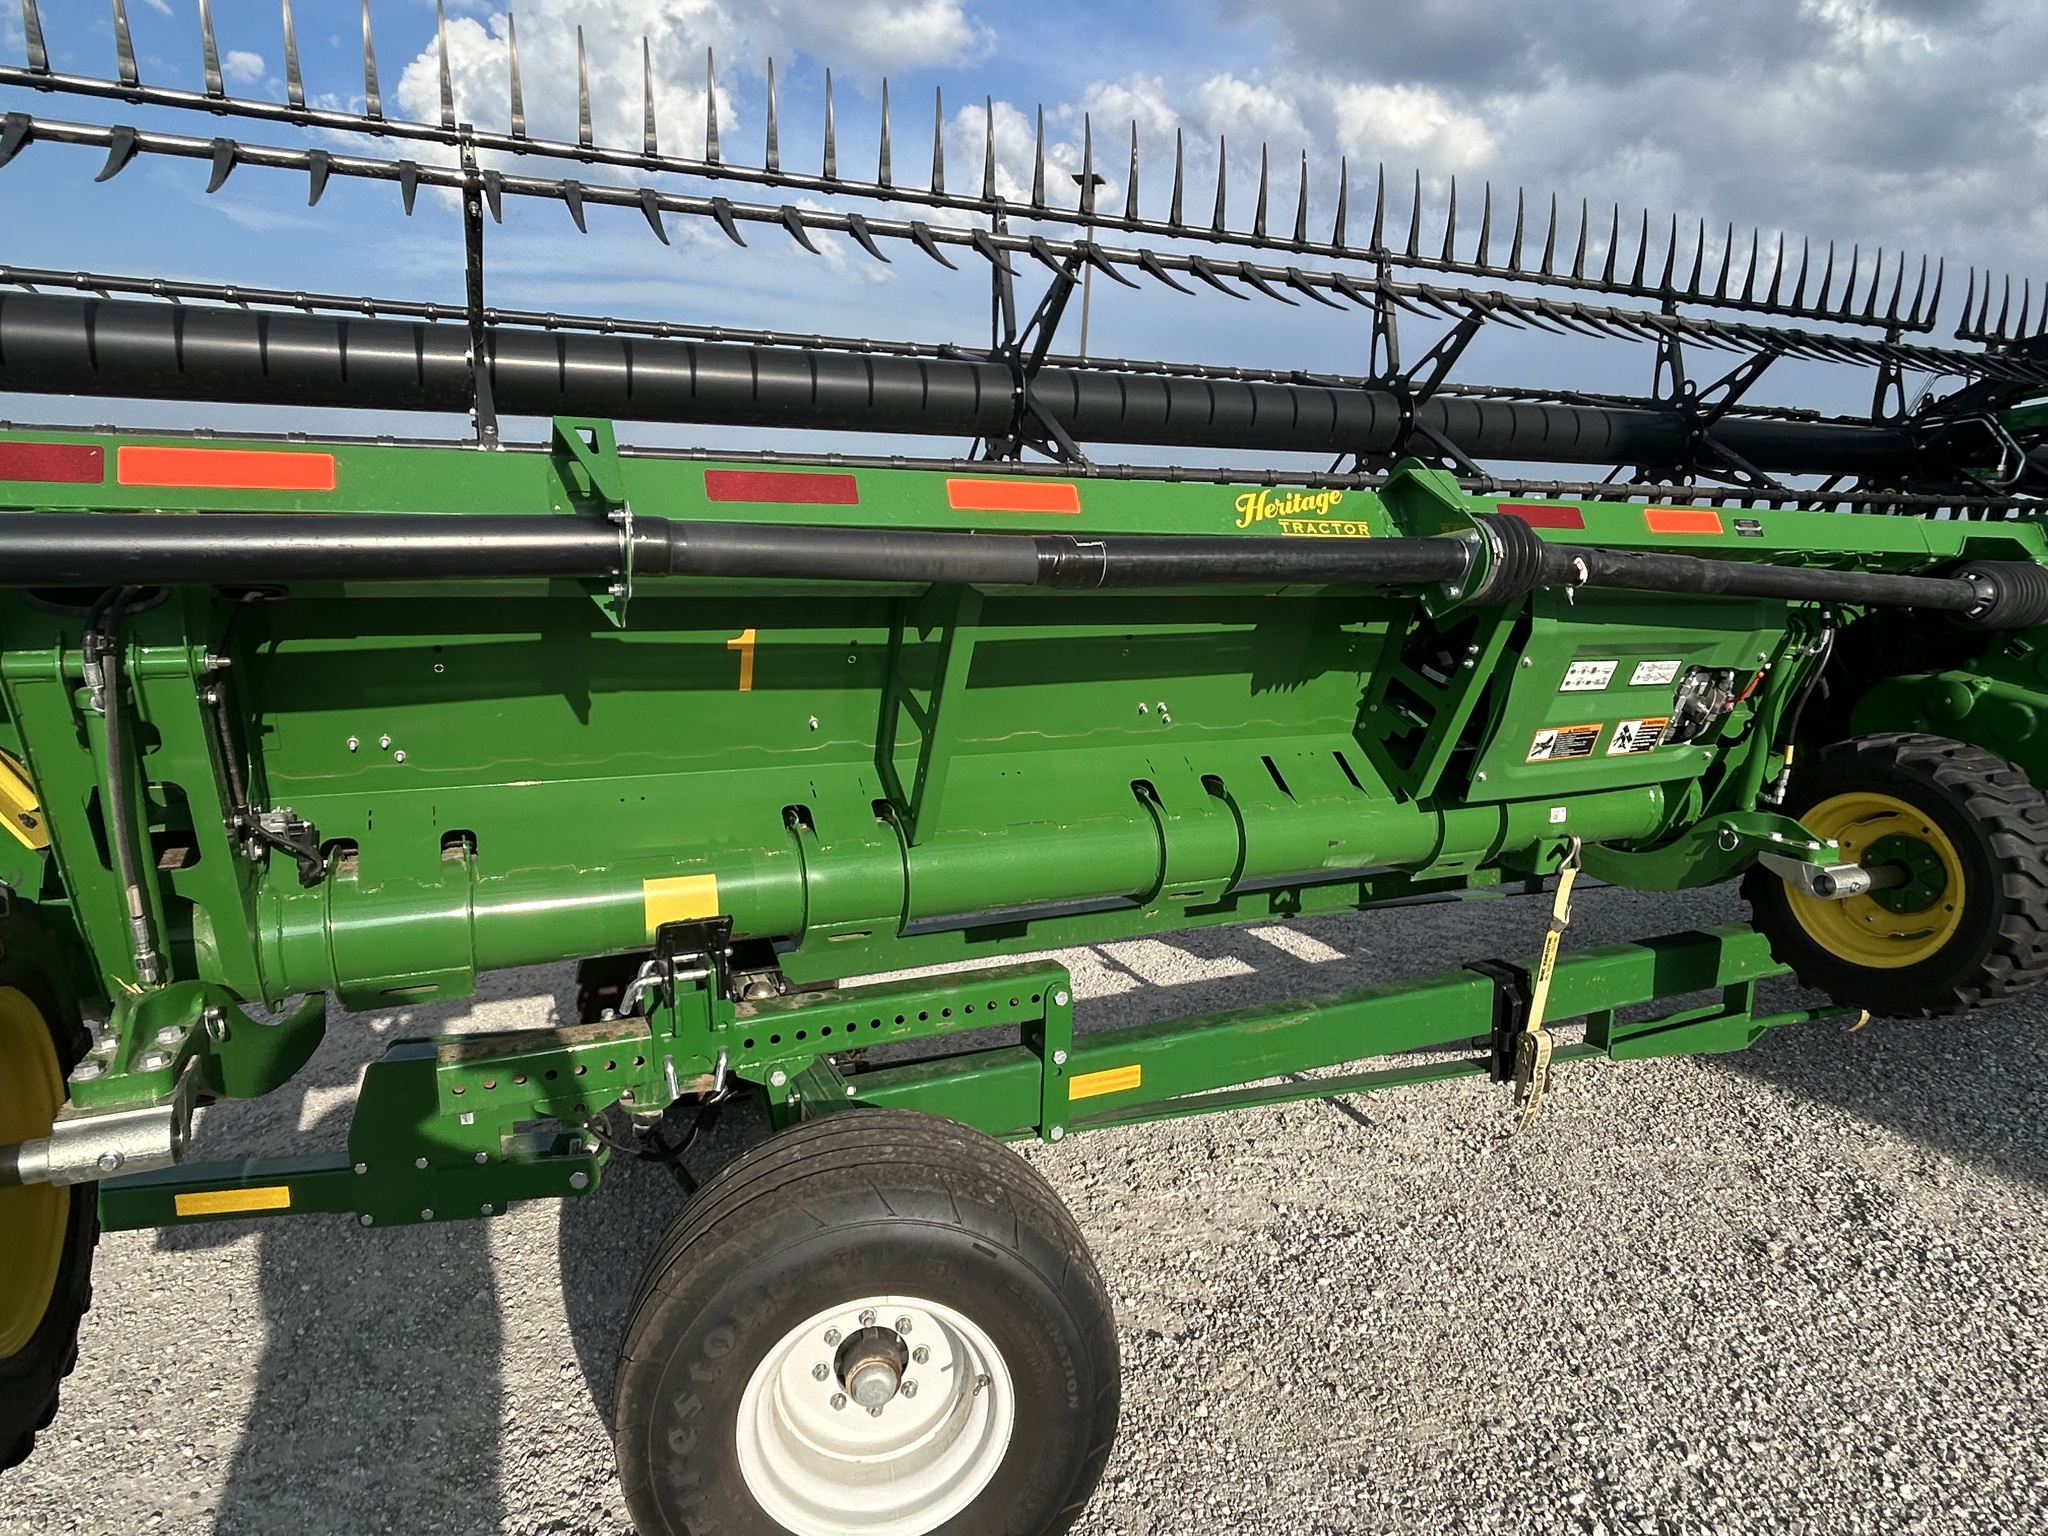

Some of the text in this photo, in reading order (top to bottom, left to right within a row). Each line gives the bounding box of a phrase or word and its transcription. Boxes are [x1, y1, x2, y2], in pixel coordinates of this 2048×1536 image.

[1235, 489, 1343, 528] Heritage
[1279, 521, 1370, 535] TRACTOR
[727, 628, 756, 691] 1
